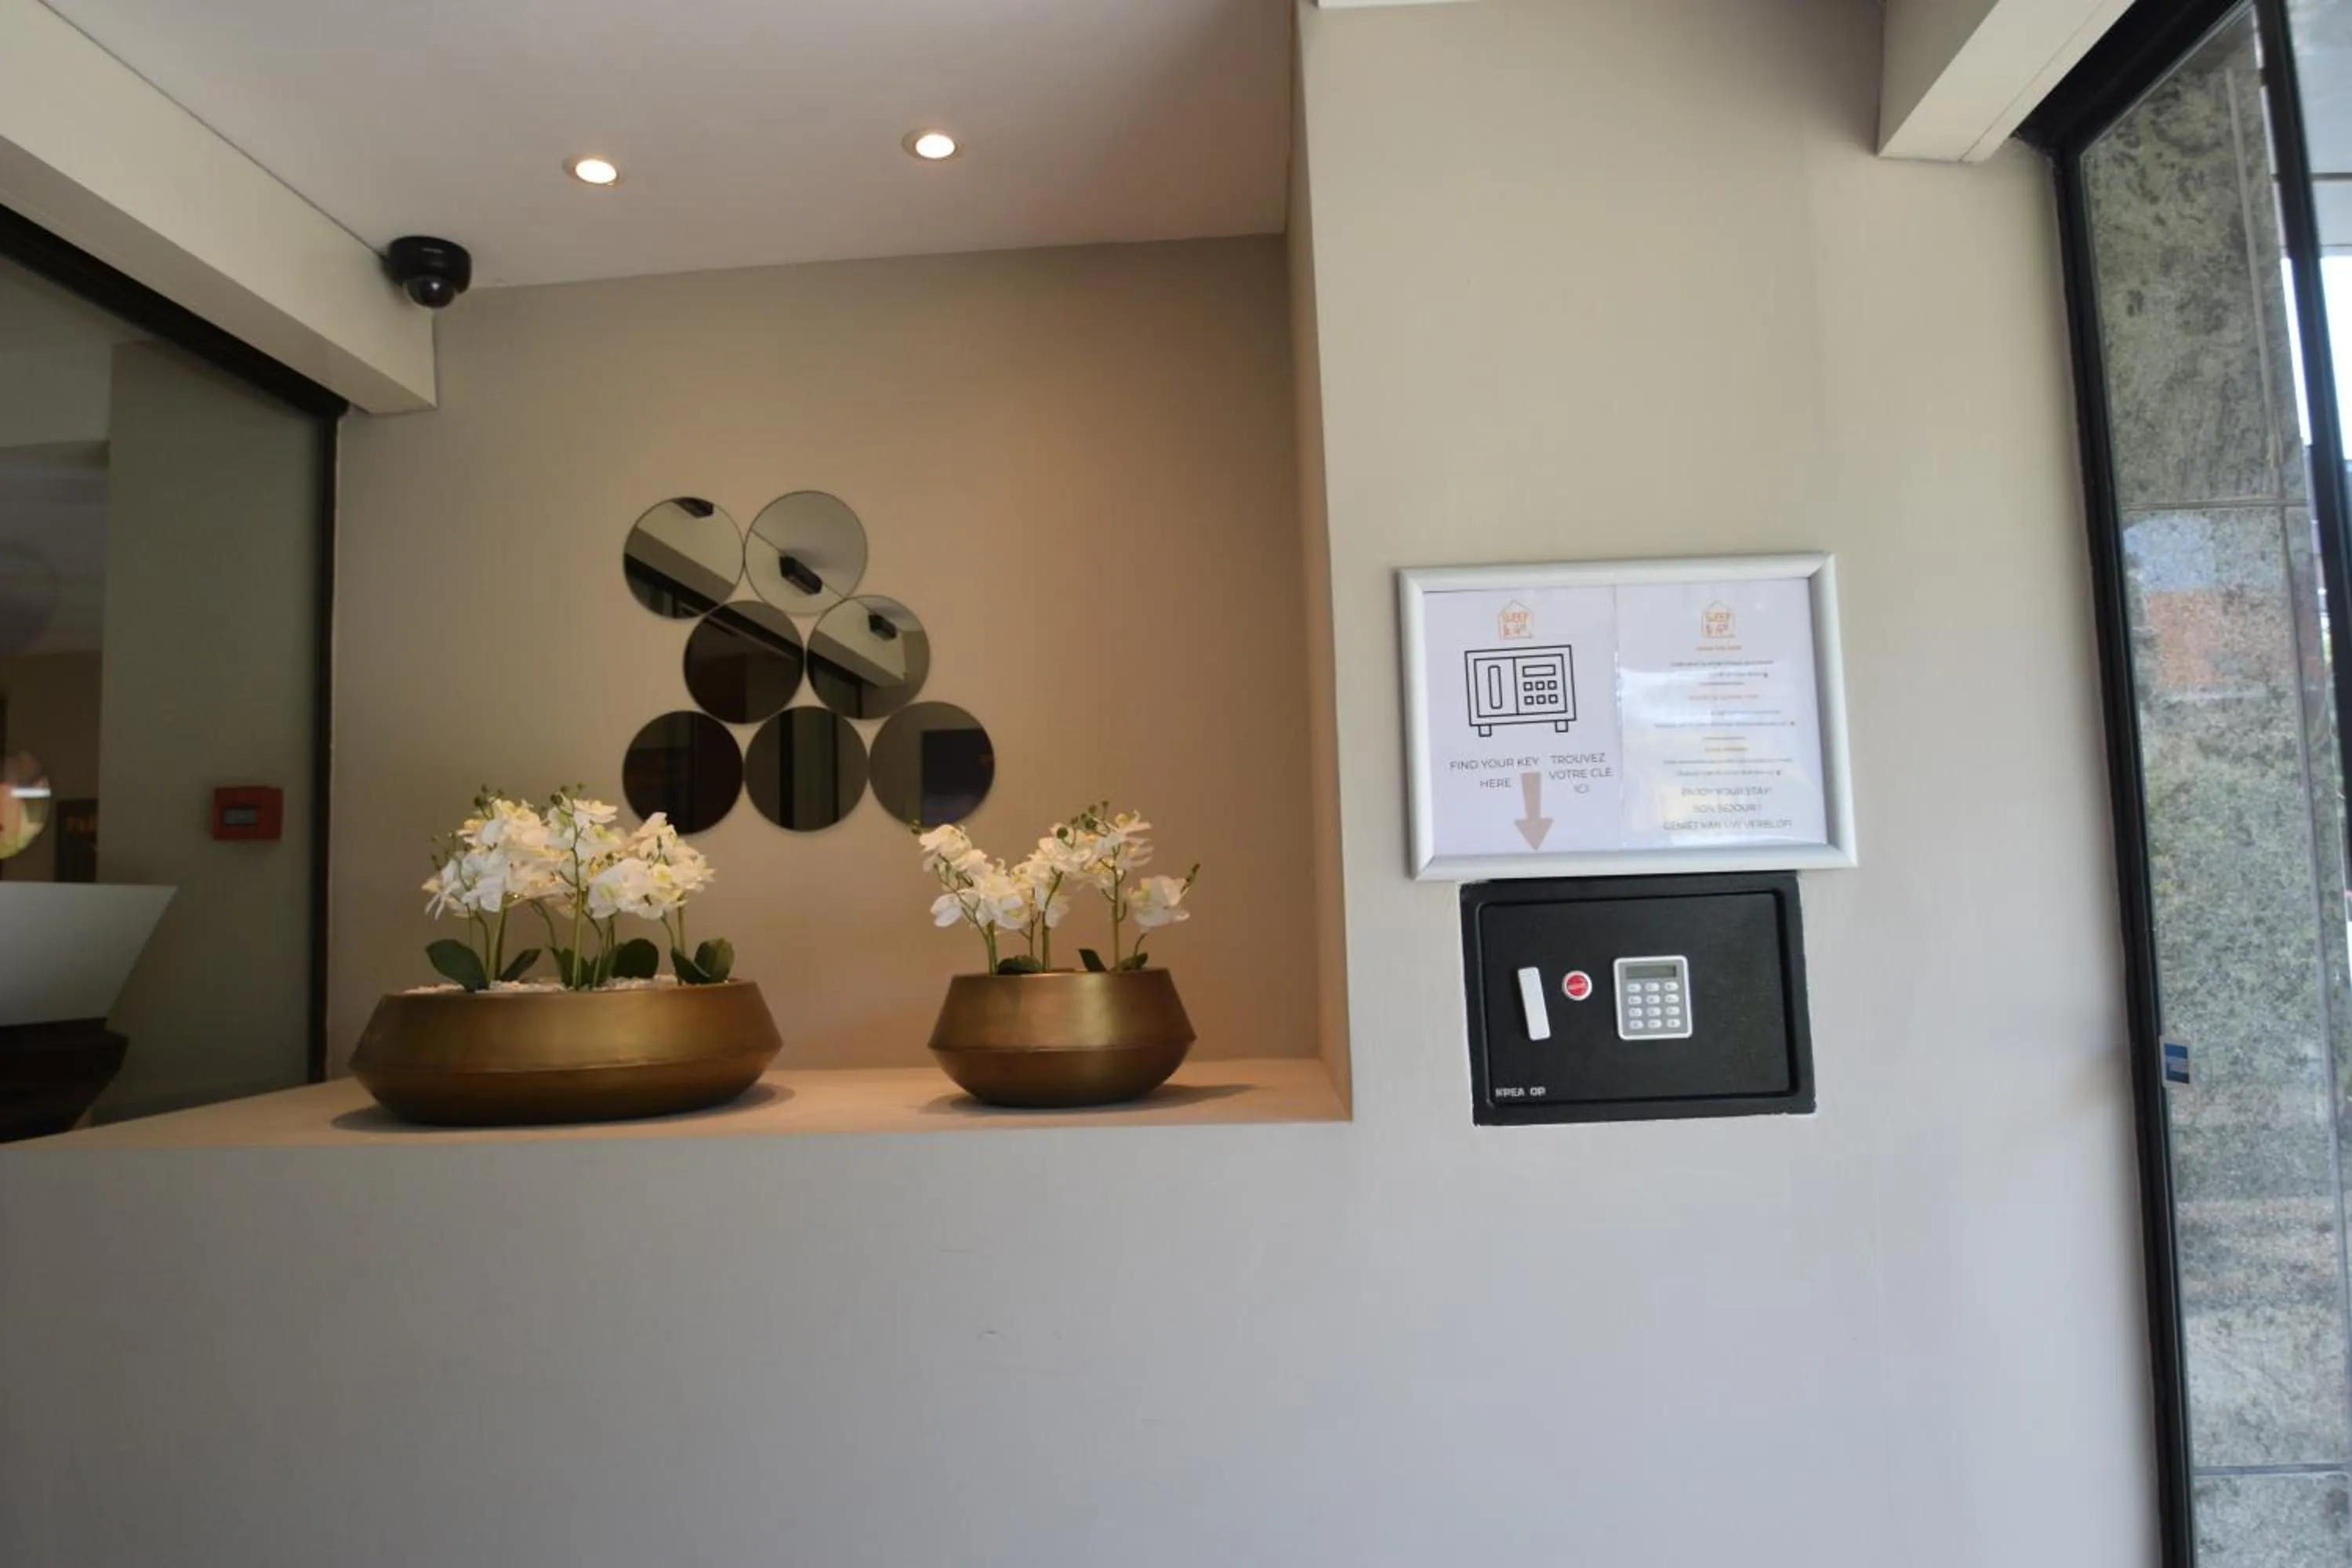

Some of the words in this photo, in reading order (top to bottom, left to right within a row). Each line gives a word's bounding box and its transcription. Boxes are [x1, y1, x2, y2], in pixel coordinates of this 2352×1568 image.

[1450, 760, 1478, 771] FIND
[1481, 757, 1514, 768] YOUR
[1517, 756, 1541, 767] KEY
[1550, 753, 1606, 764] TROUVEZ
[1548, 768, 1587, 780] VOTRE
[1479, 778, 1512, 789] HERE
